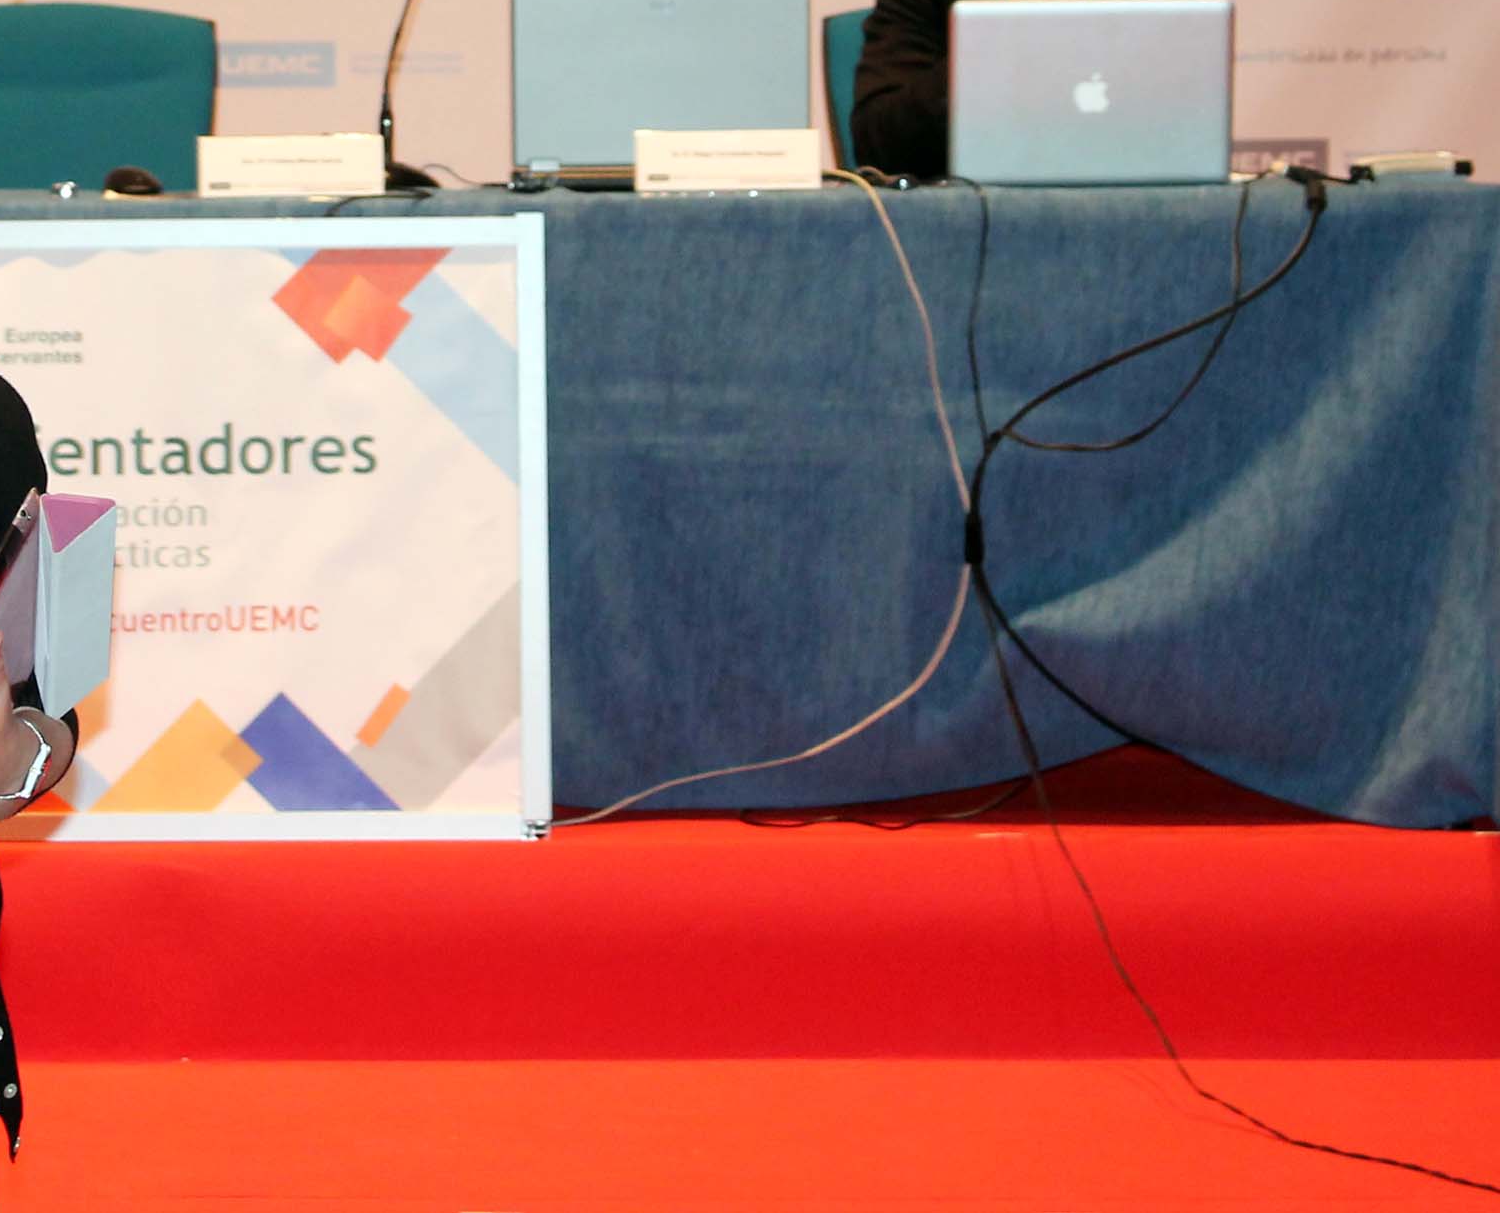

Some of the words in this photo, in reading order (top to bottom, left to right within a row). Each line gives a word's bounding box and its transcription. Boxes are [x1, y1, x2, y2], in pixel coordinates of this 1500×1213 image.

[5, 326, 83, 347] Europea
[35, 422, 378, 477] entadores
[115, 498, 208, 527] ación
[114, 540, 212, 569] cticas
[110, 605, 320, 633] cuentroUEMC
